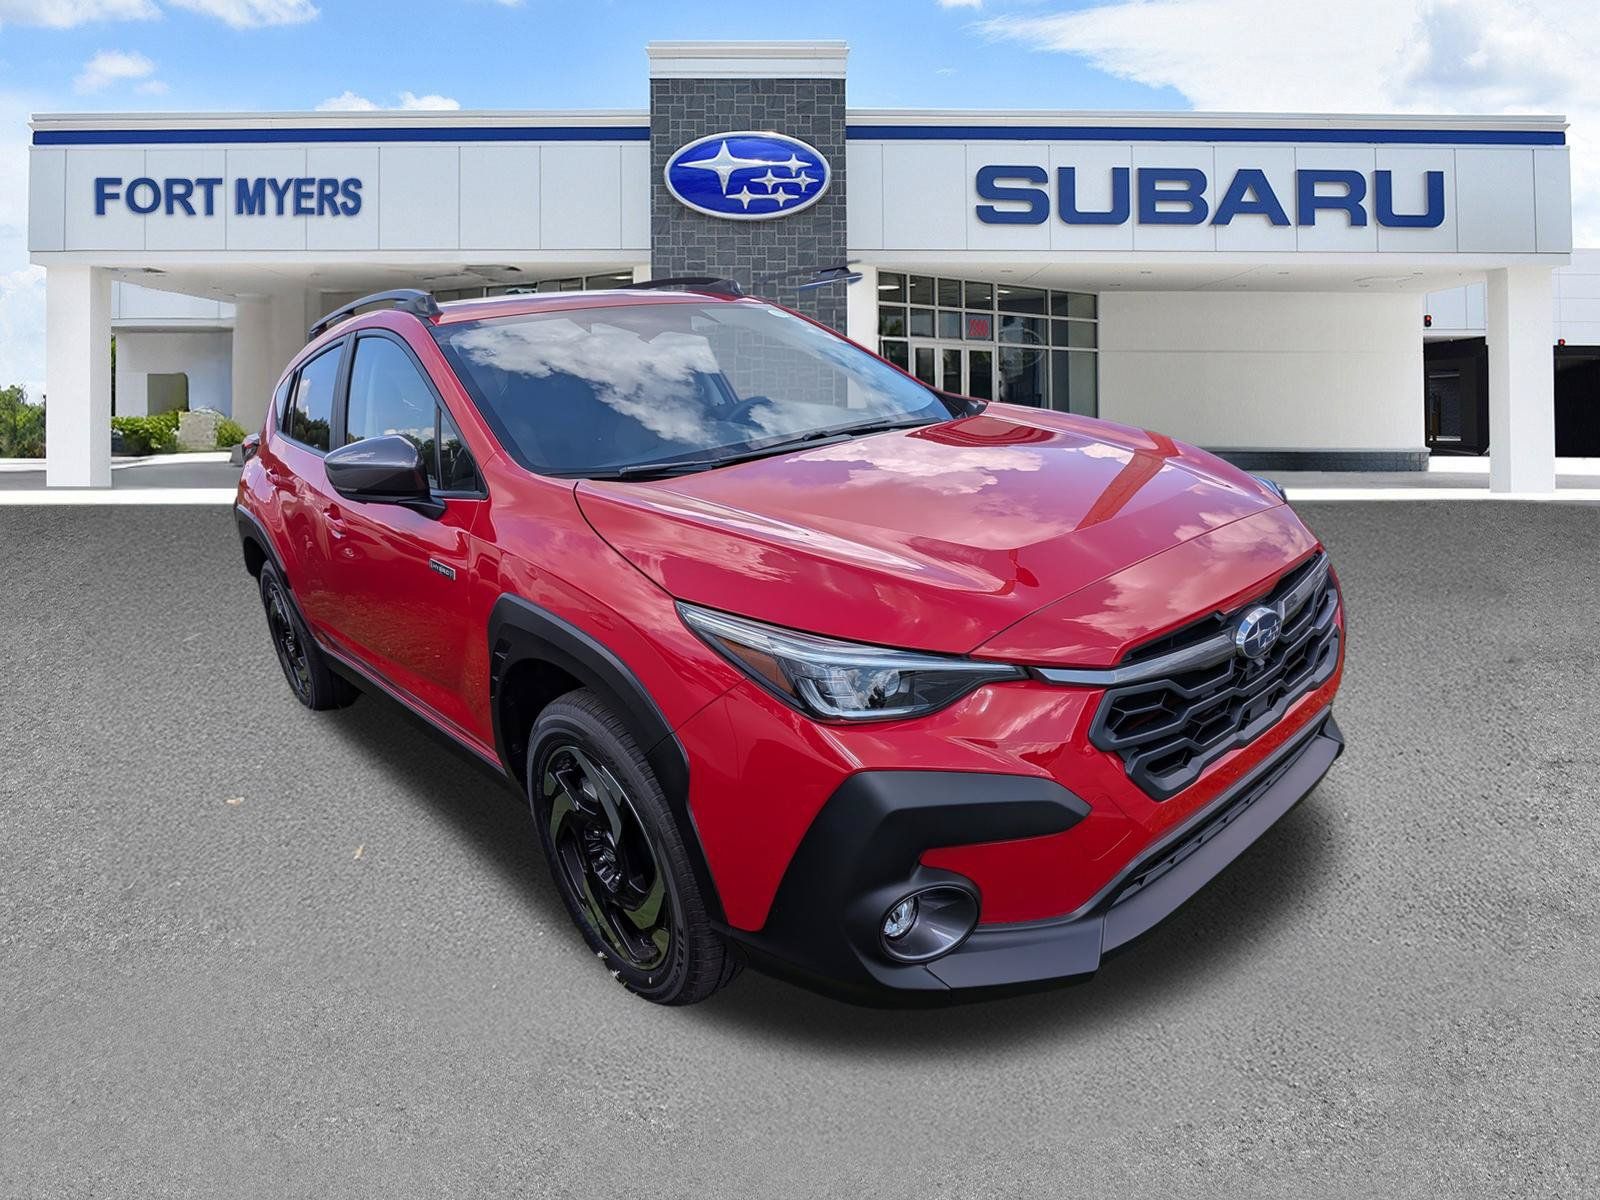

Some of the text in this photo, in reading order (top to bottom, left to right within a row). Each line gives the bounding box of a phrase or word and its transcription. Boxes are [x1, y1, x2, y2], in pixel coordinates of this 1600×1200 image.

[94, 177, 362, 216] FORT MYERS
[975, 164, 1445, 228] SUBARU
